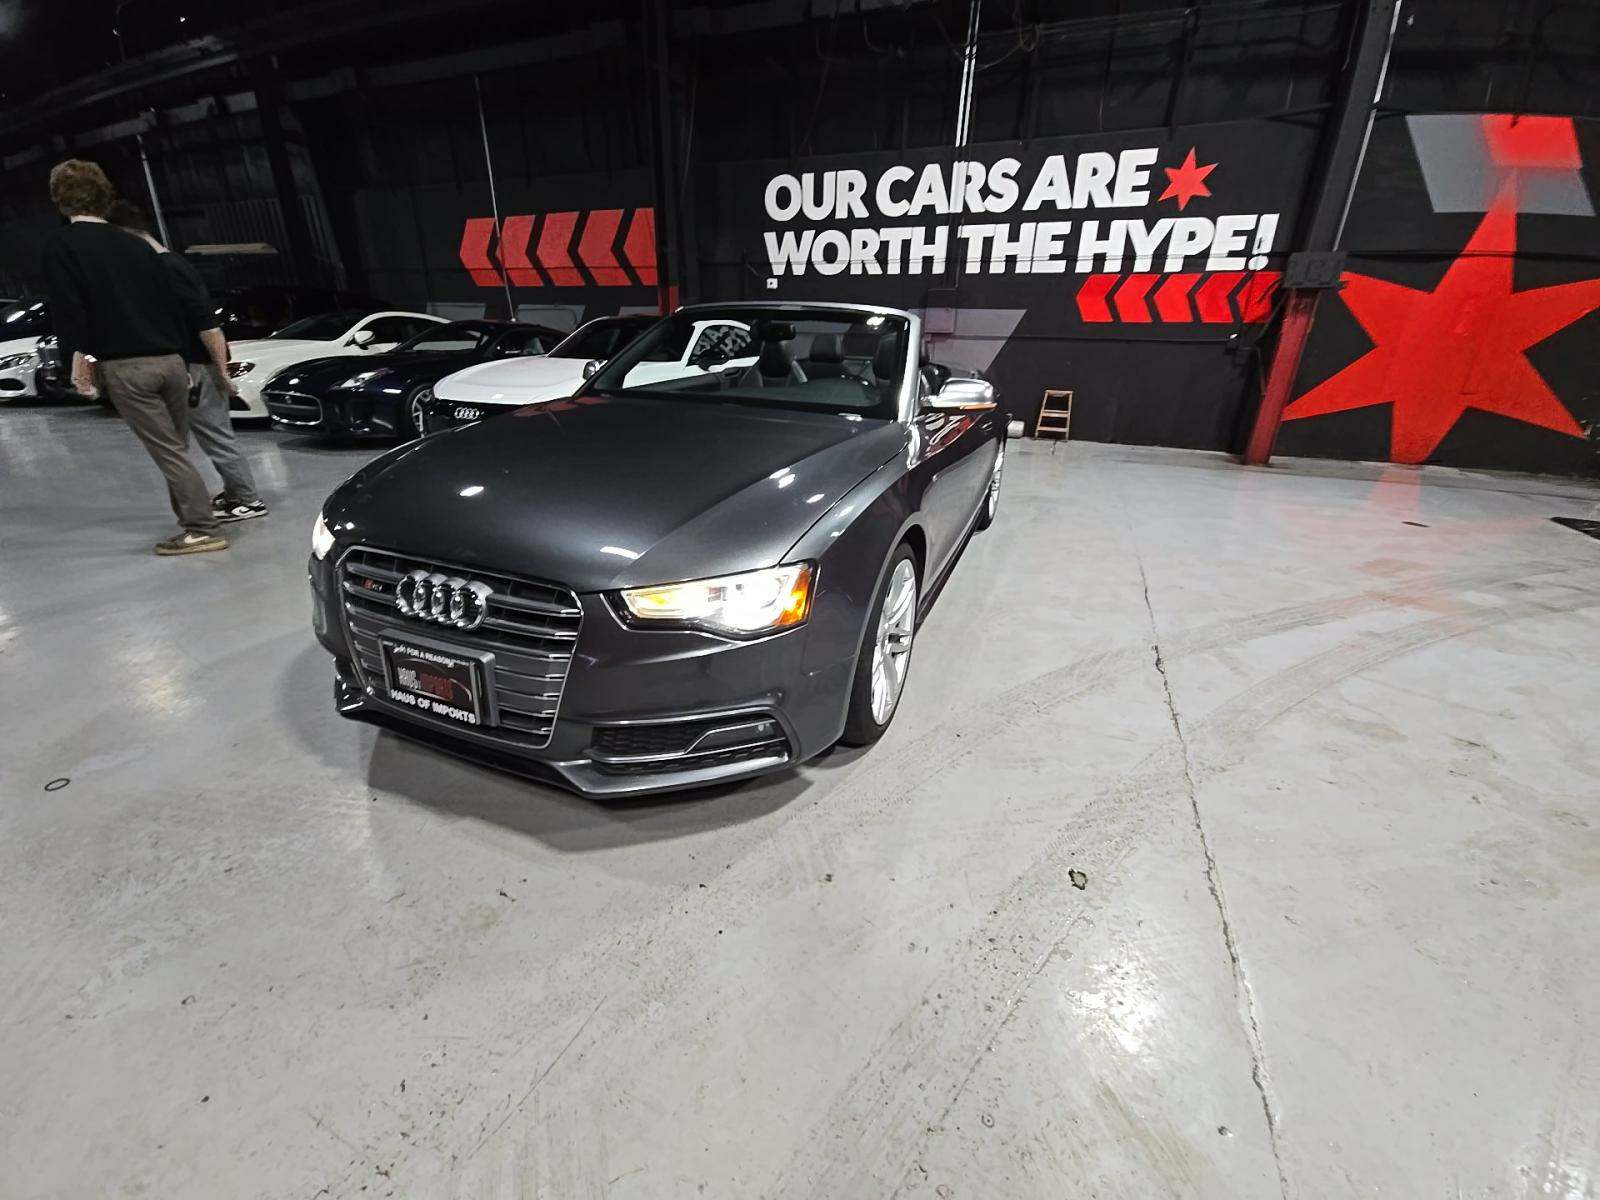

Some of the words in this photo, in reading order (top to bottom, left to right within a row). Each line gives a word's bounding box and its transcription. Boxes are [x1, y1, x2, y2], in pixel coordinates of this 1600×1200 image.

[764, 170, 868, 222] OUR
[875, 158, 1021, 214] CARS
[1022, 148, 1159, 211] ARE
[764, 225, 949, 276] WORTH
[958, 221, 1070, 274] THE
[1075, 213, 1280, 273] HYPE!
[390, 689, 416, 705] HAUS
[417, 697, 430, 709] OF
[432, 701, 475, 724] IMPORTS
